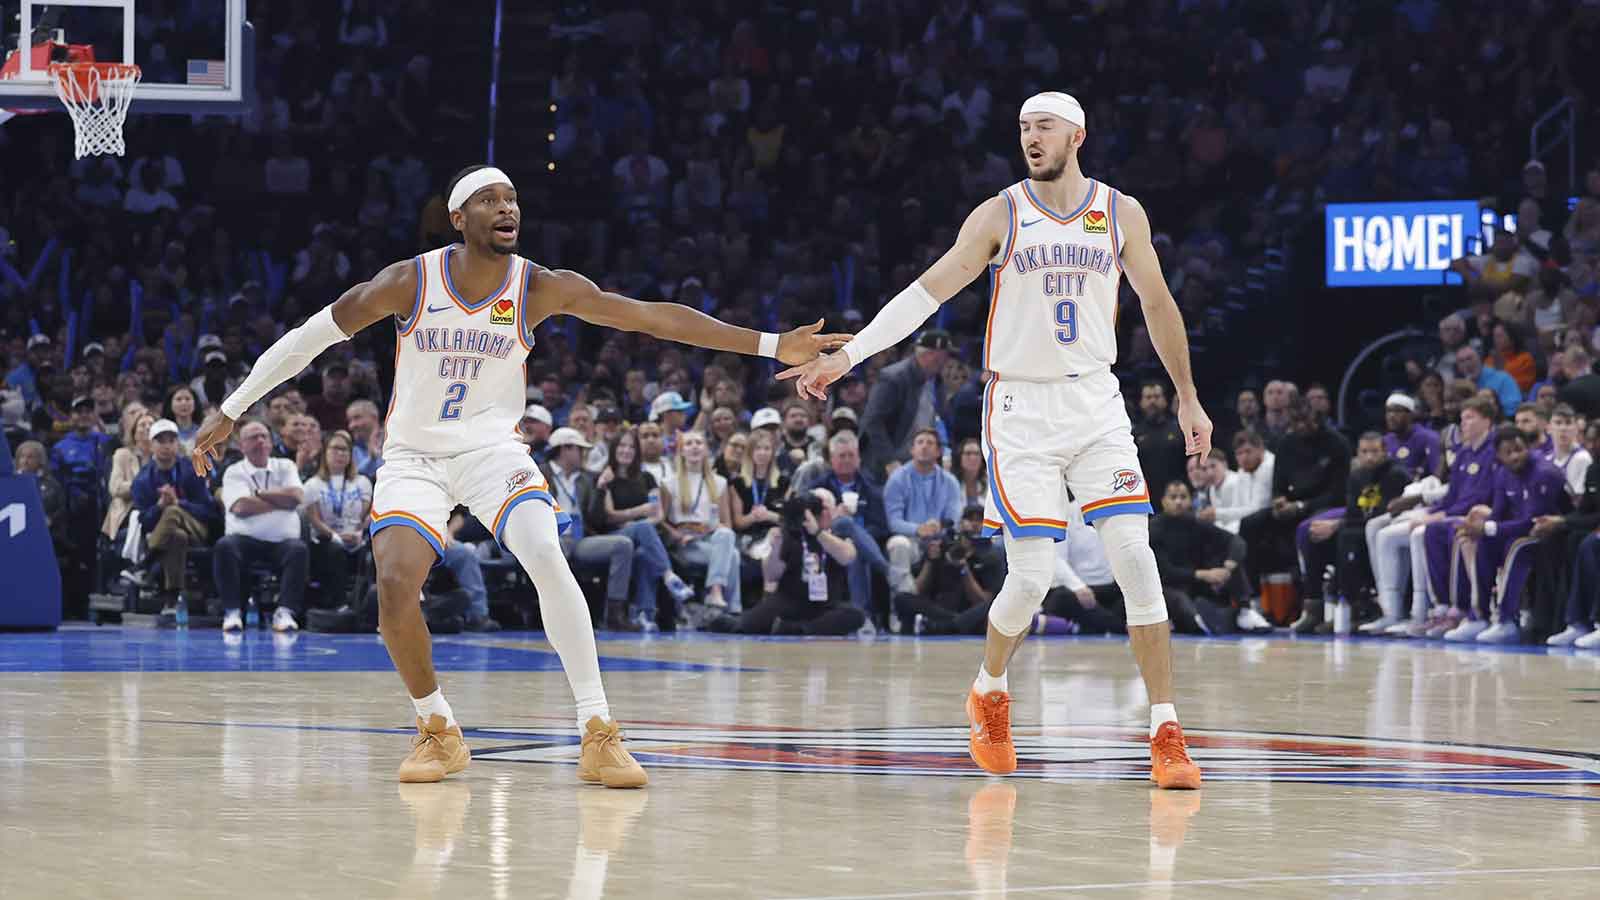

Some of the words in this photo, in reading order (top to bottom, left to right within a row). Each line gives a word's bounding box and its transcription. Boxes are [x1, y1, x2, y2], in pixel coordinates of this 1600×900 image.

[1013, 243, 1113, 276] OKLAHOMA
[1043, 272, 1087, 296] CITY
[1054, 299, 1079, 345] 9
[415, 328, 516, 359] OKLAHOMA
[438, 357, 484, 380] CITY
[439, 381, 469, 421] 2
